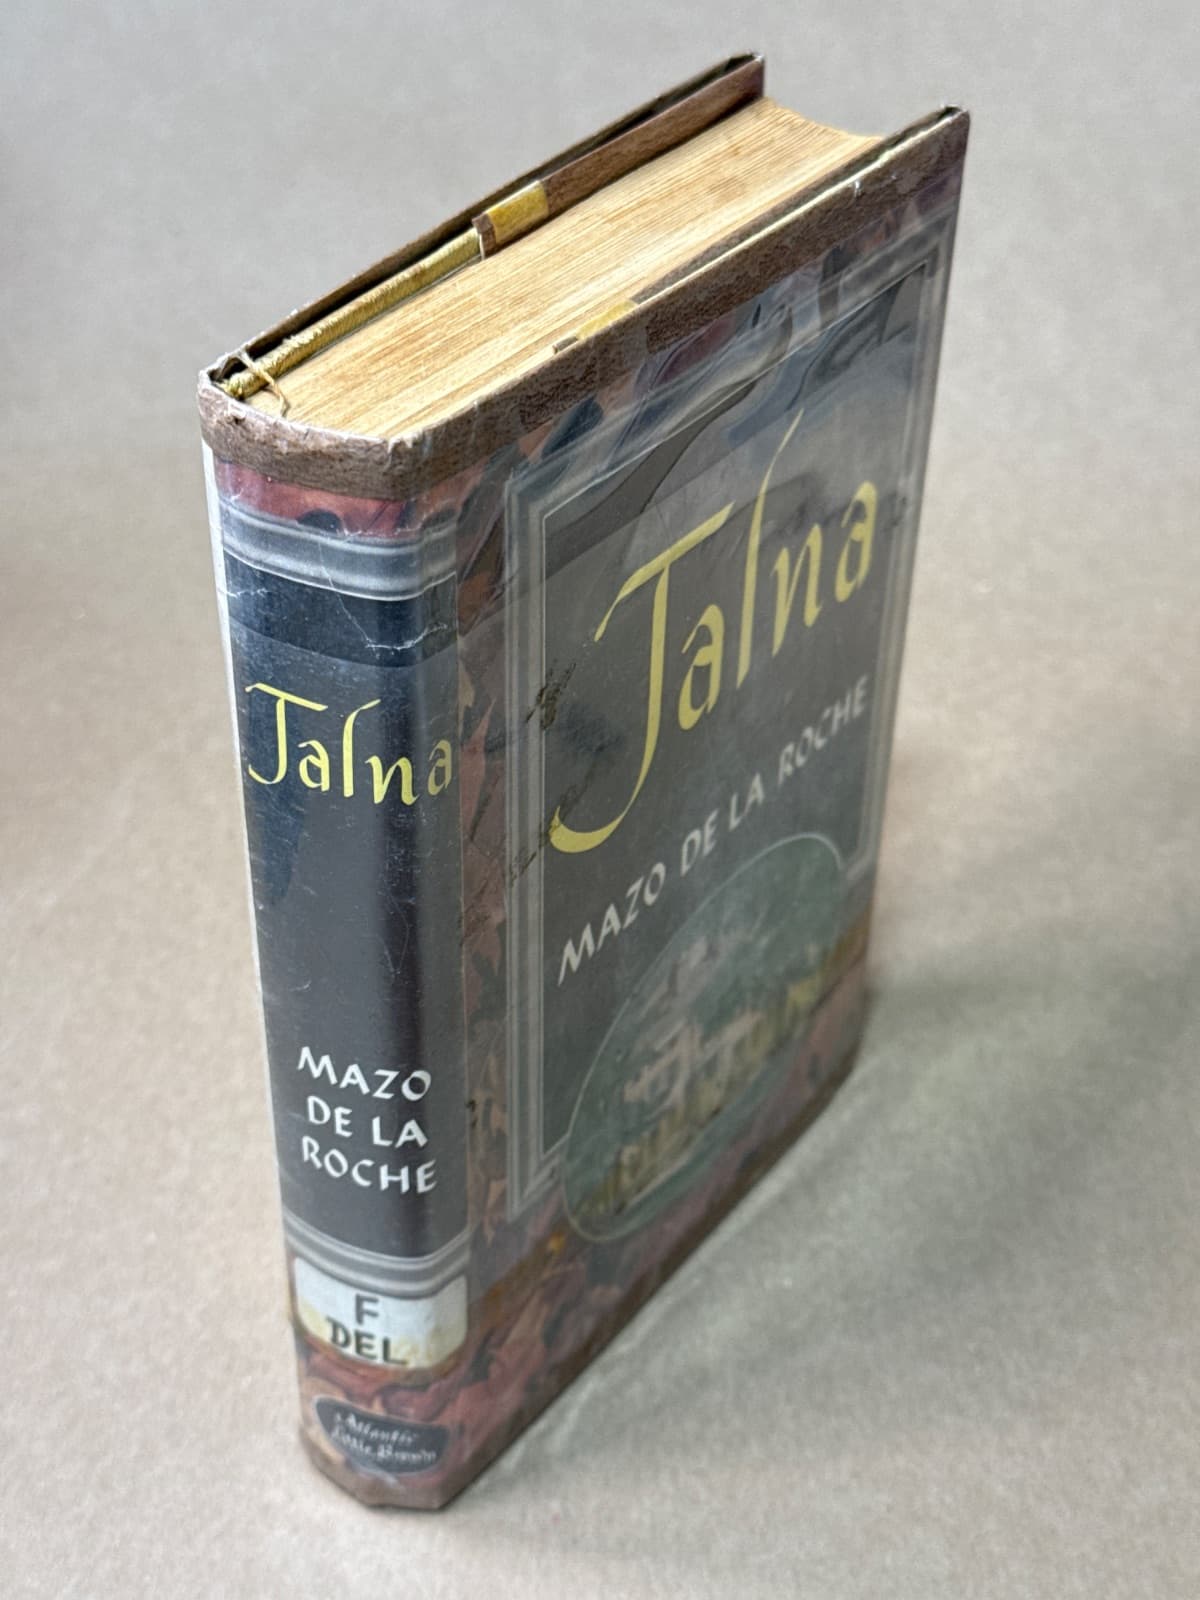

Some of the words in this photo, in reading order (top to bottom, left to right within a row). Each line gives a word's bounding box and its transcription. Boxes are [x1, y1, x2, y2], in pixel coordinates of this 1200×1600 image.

[549, 407, 878, 854] Jalna
[244, 682, 453, 806] Jalna
[557, 861, 666, 988] MAZO
[679, 807, 720, 878] DE
[728, 771, 766, 832] LA
[777, 673, 869, 788] ROCHE
[297, 1045, 433, 1101] MAZO
[306, 1095, 353, 1138] DE
[371, 1115, 429, 1149] LA
[301, 1135, 439, 1195] ROCHE
[354, 1293, 380, 1326] F
[325, 1314, 409, 1366] DEL
